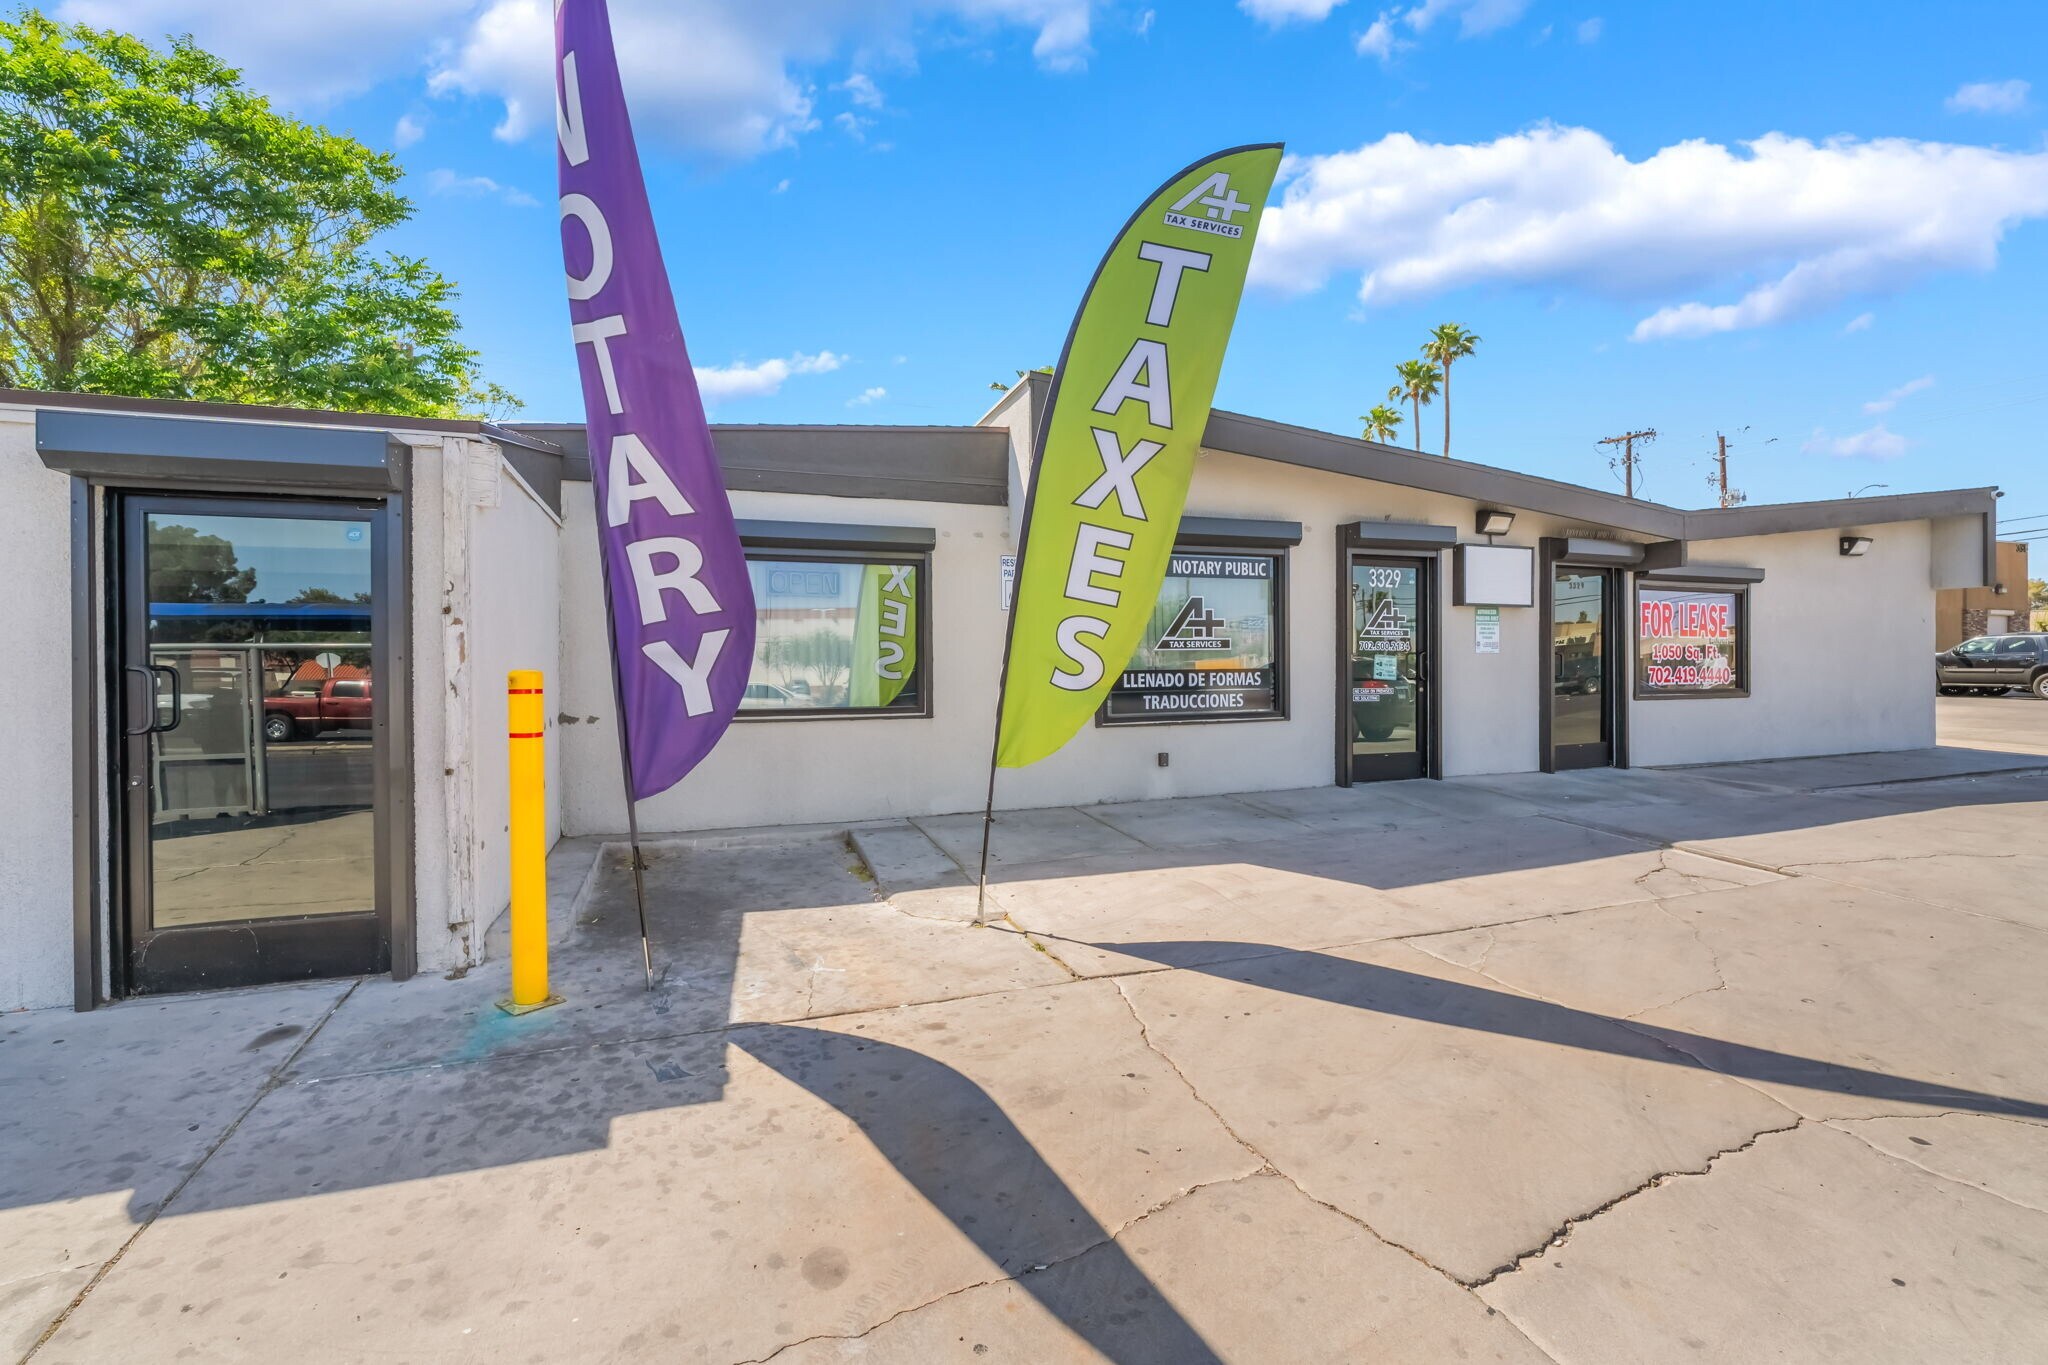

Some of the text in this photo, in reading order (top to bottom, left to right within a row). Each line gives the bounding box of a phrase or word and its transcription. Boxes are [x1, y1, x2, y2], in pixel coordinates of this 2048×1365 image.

[1166, 214, 1240, 236] TAX SERVICES
[1049, 240, 1213, 692] TAXES
[1172, 560, 1267, 576] NOTARY PUBLIC
[1368, 568, 1401, 588] 3329
[770, 572, 839, 595] OPEN
[1640, 602, 1729, 639] FOR LEASE
[1652, 644, 1682, 662] 1,050
[1684, 645, 1704, 661] Sq.
[1123, 671, 1262, 688] LLENADO DE FORMAS
[1649, 665, 1731, 685] 702.419.4440
[1143, 693, 1244, 710] TRADUCCIONES
